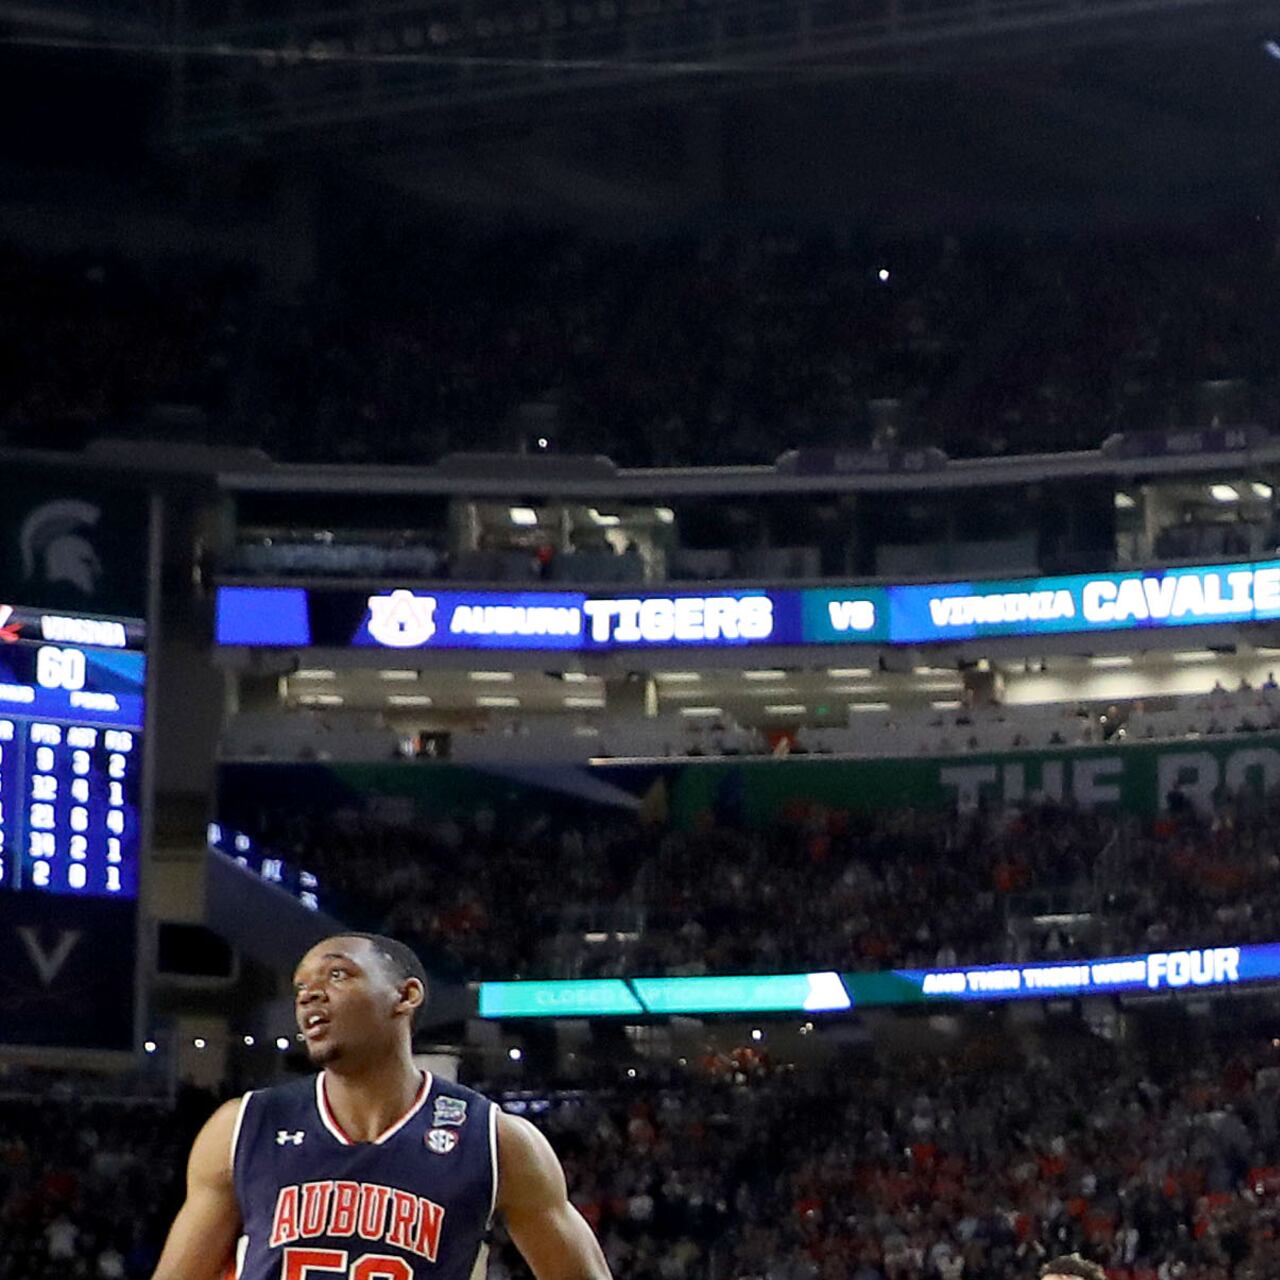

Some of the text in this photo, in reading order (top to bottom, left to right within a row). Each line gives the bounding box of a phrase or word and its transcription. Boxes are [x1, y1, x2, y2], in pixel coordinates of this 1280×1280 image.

[450, 606, 581, 635] AUBURN
[583, 597, 773, 642] TIGERS
[828, 601, 875, 631] VS
[929, 590, 1076, 627] VIRGINIA
[37, 646, 85, 690] 60
[1147, 948, 1239, 988] FOUR
[269, 1181, 445, 1263] AUBURN
